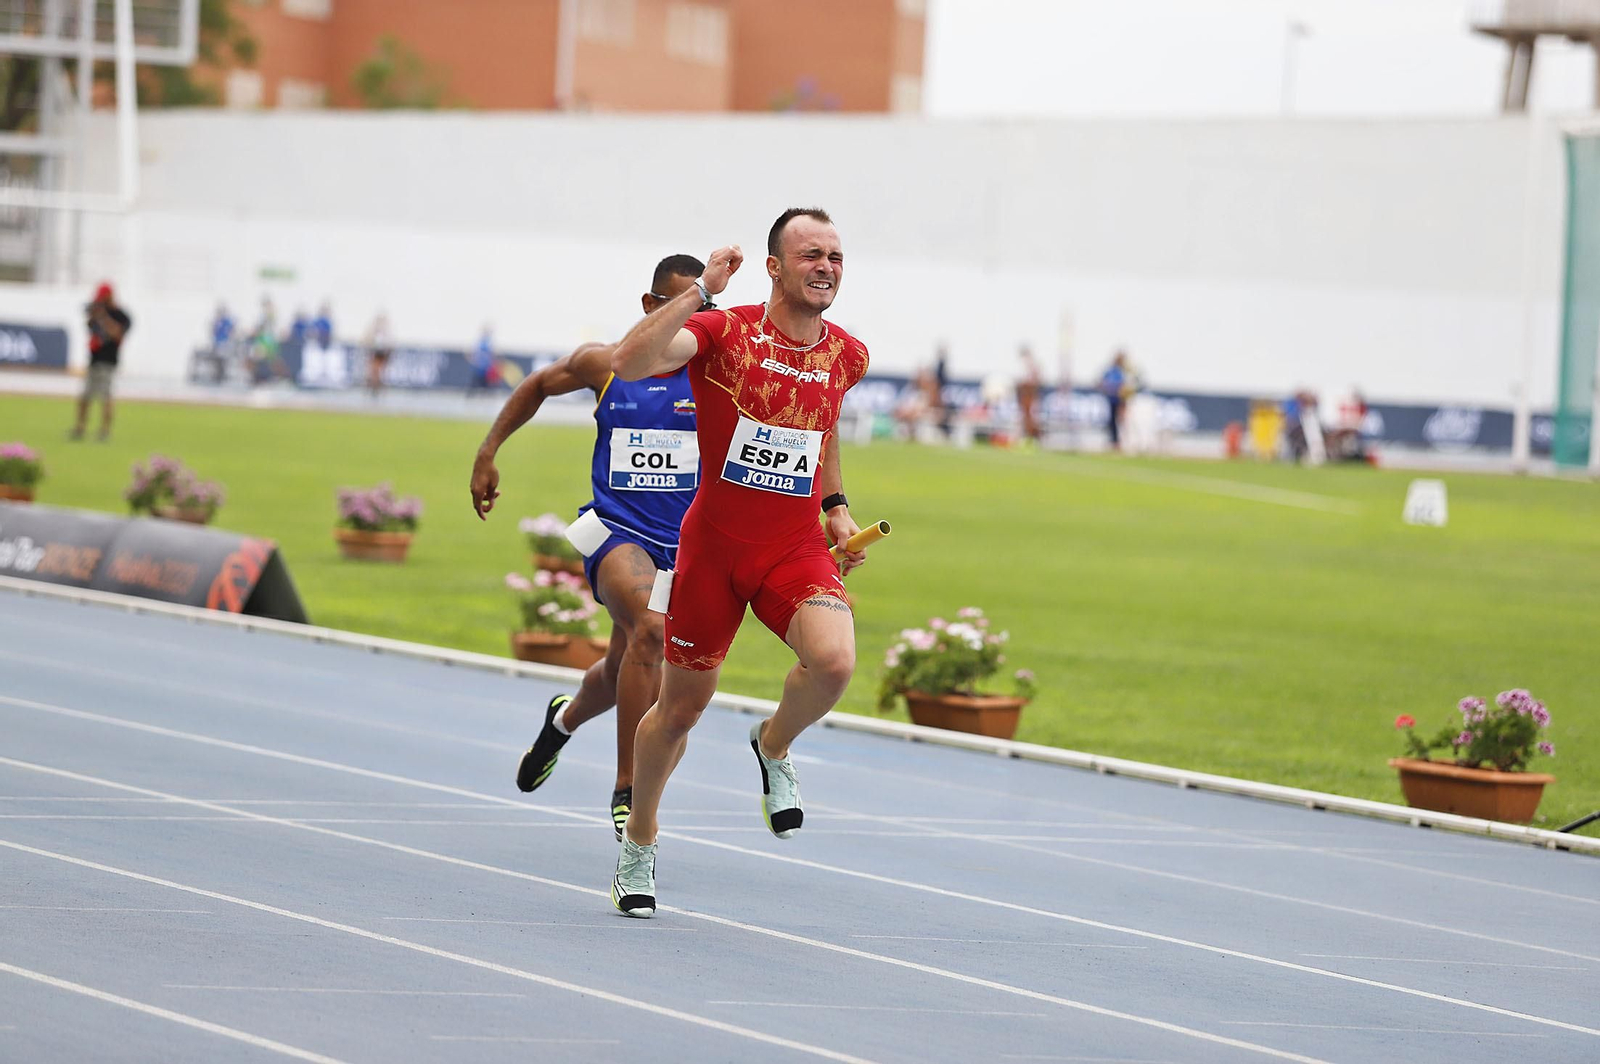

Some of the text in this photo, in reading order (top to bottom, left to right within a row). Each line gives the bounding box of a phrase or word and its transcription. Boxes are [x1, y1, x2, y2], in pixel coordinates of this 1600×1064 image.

[760, 358, 831, 383] ESPAÑA
[629, 432, 643, 444] H
[755, 427, 772, 441] H
[783, 437, 807, 446] HUELVA
[631, 452, 678, 469] COL
[739, 444, 808, 473] ESP A
[670, 635, 695, 648] ESP
